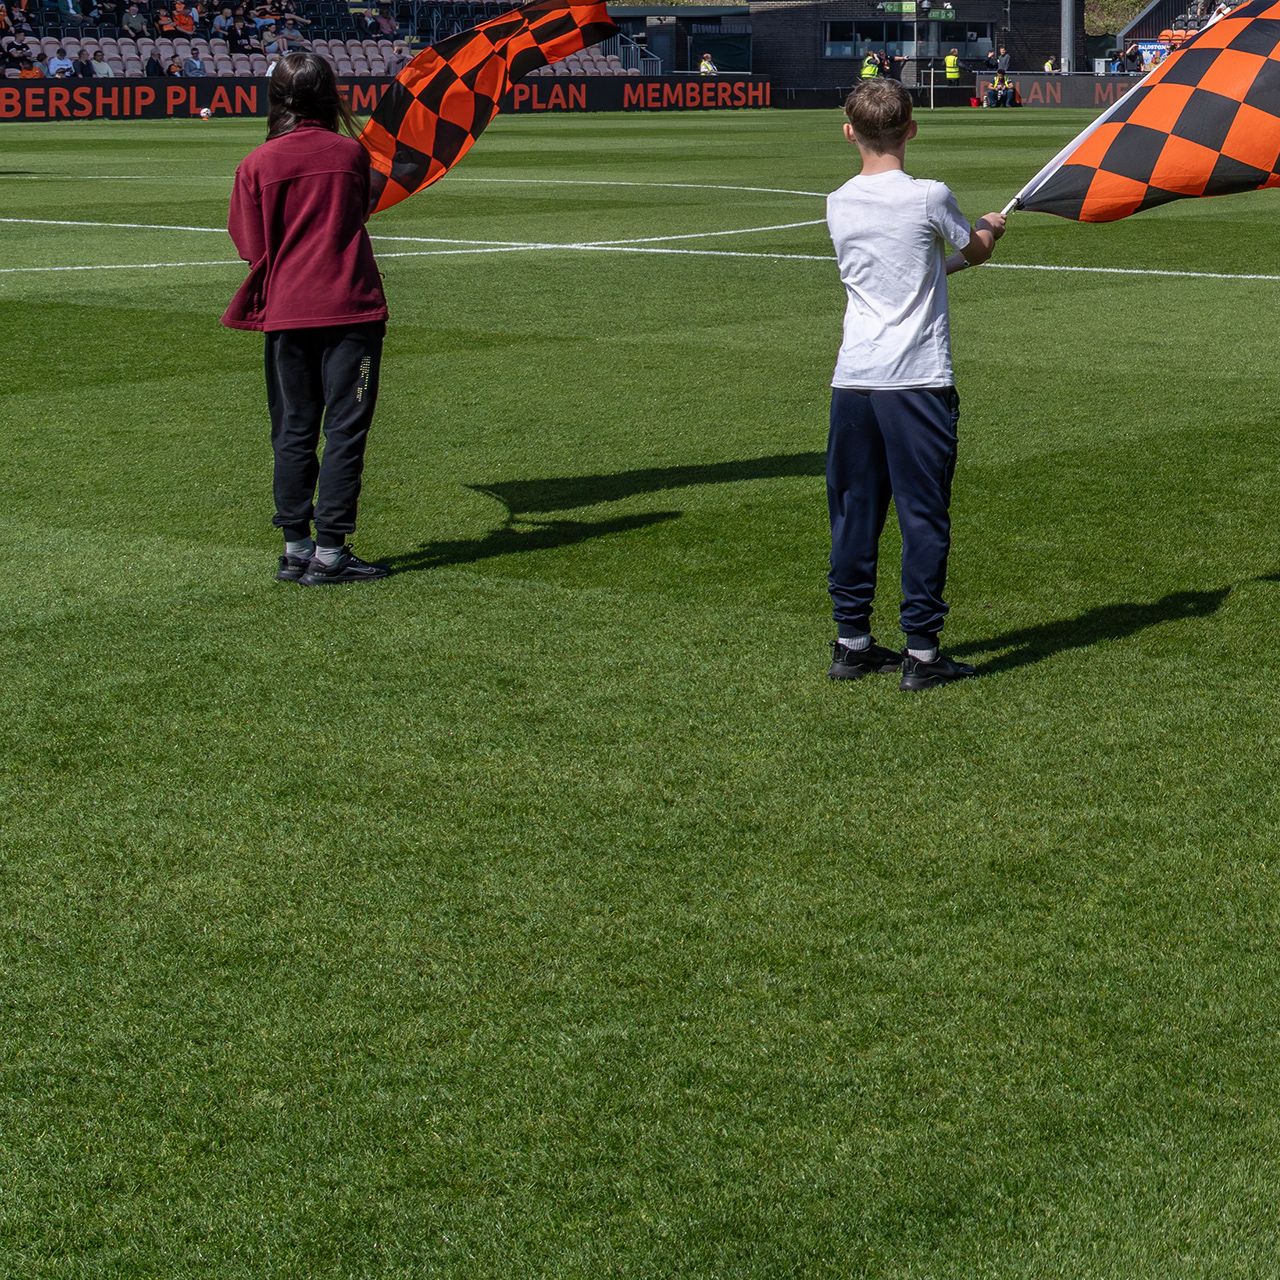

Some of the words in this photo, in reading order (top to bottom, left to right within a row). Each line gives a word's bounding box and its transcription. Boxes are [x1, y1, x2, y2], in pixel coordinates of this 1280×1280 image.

[0, 86, 155, 118] BERSHIP
[167, 85, 257, 115] PLAN
[513, 83, 587, 110] PLAN
[623, 81, 771, 108] MEMBERSHI
